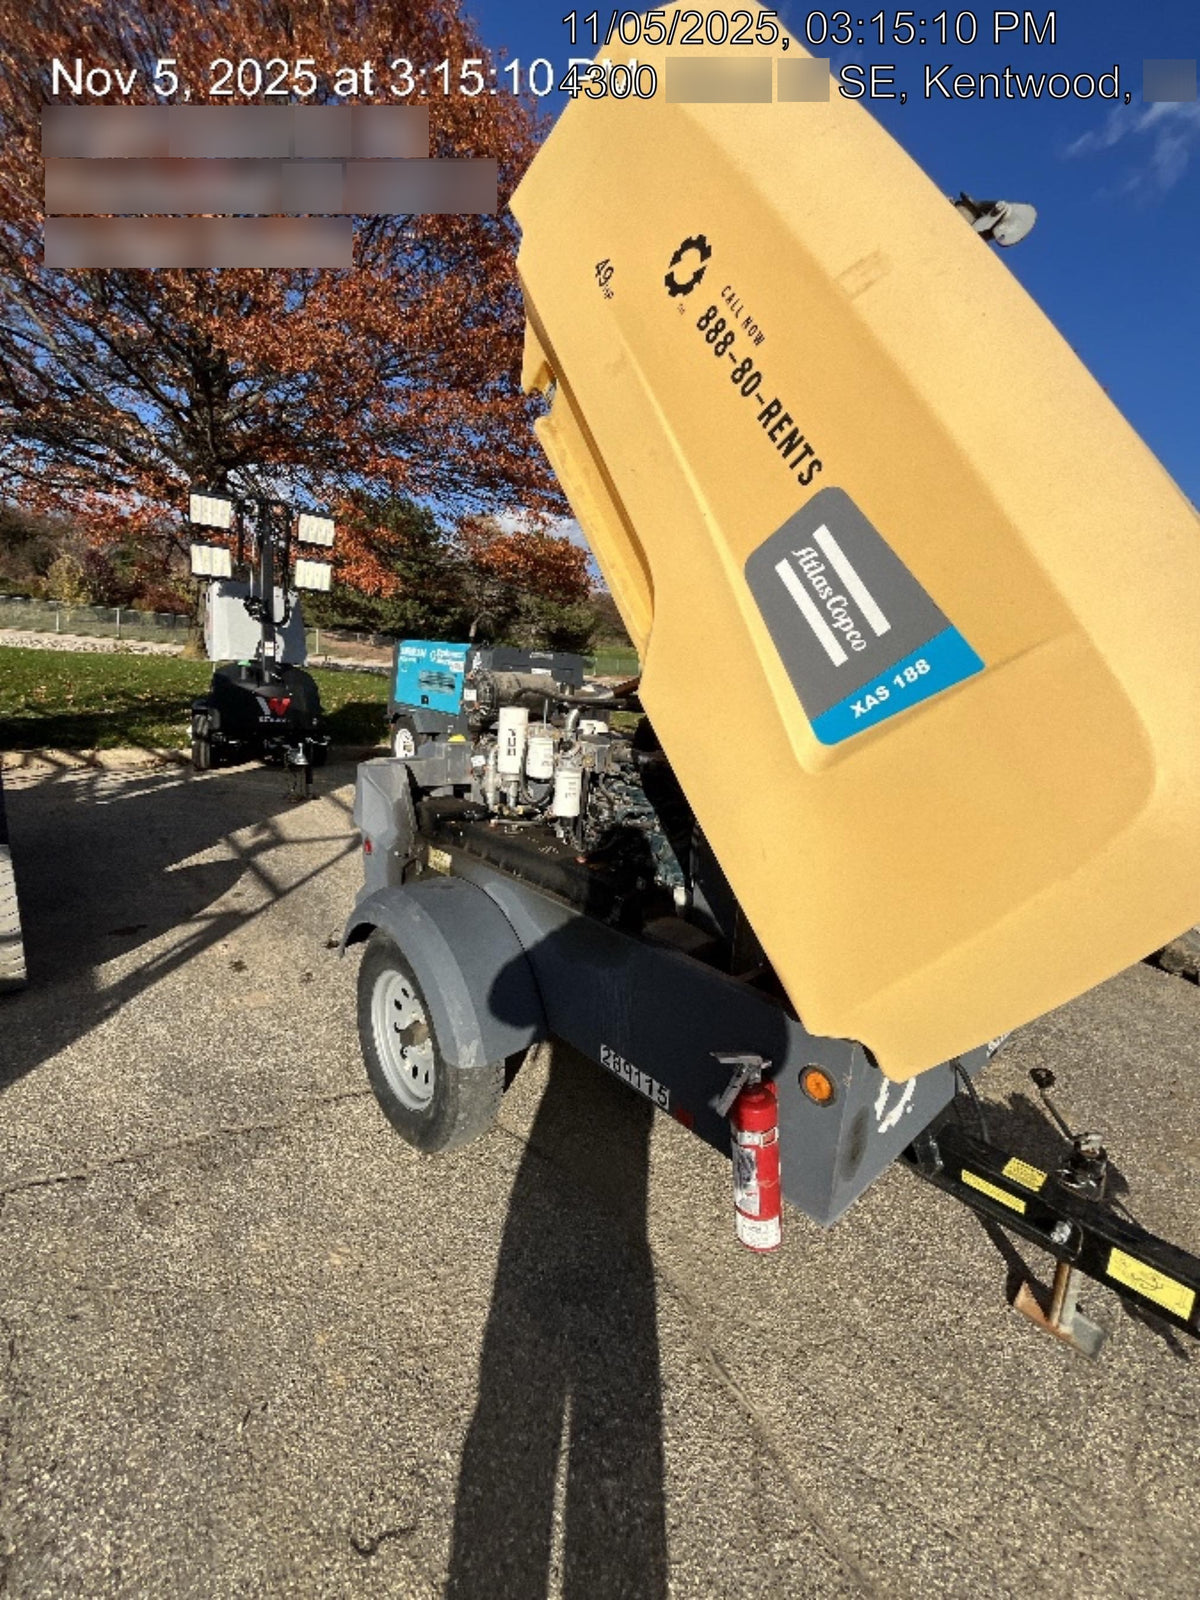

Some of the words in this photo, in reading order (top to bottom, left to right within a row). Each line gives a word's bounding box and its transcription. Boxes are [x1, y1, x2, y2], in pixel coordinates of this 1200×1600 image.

[720, 285, 744, 320] CALL
[741, 315, 766, 346] NOW
[696, 304, 823, 487] 888-80-RENTS
[849, 685, 891, 719] XAS
[893, 658, 932, 689] 188
